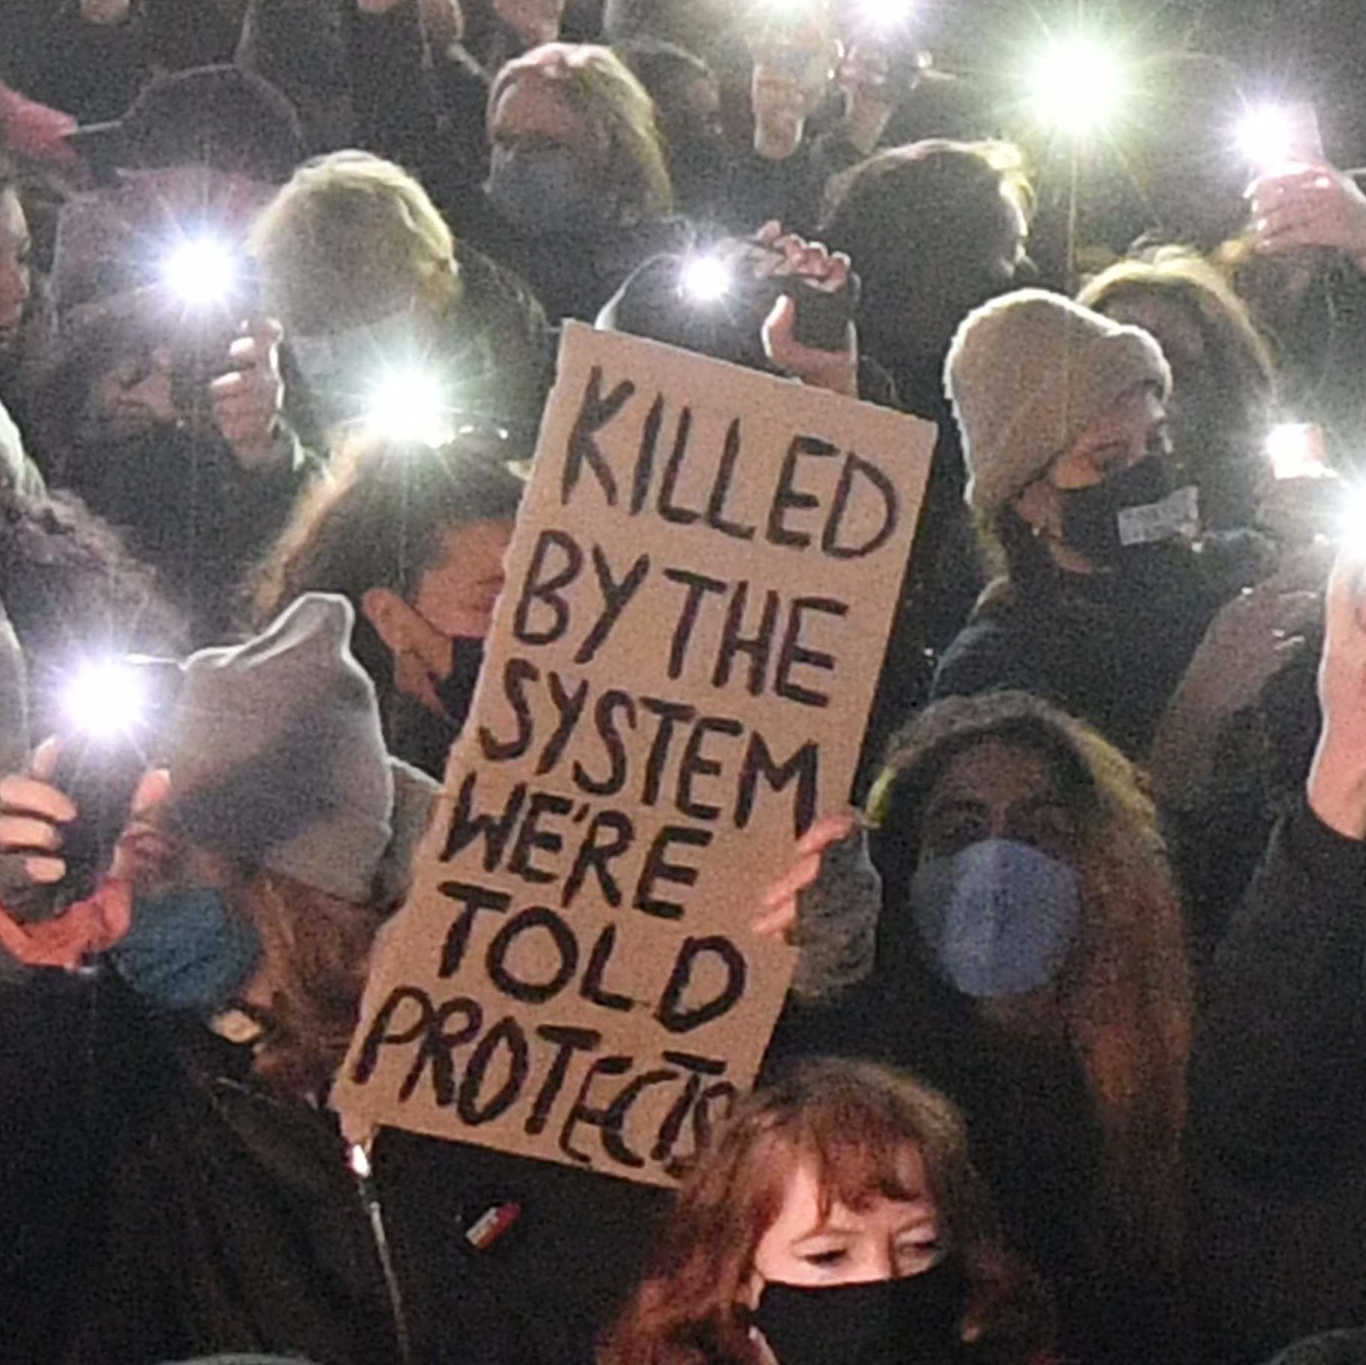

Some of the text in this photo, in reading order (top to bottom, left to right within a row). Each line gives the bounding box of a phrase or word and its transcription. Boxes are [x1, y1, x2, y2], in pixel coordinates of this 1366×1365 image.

[562, 366, 898, 559] KILLED
[513, 530, 849, 708] BY THE
[479, 659, 819, 831] SYSTEM
[439, 774, 715, 921] WE'RE
[437, 882, 748, 1032] TOLD
